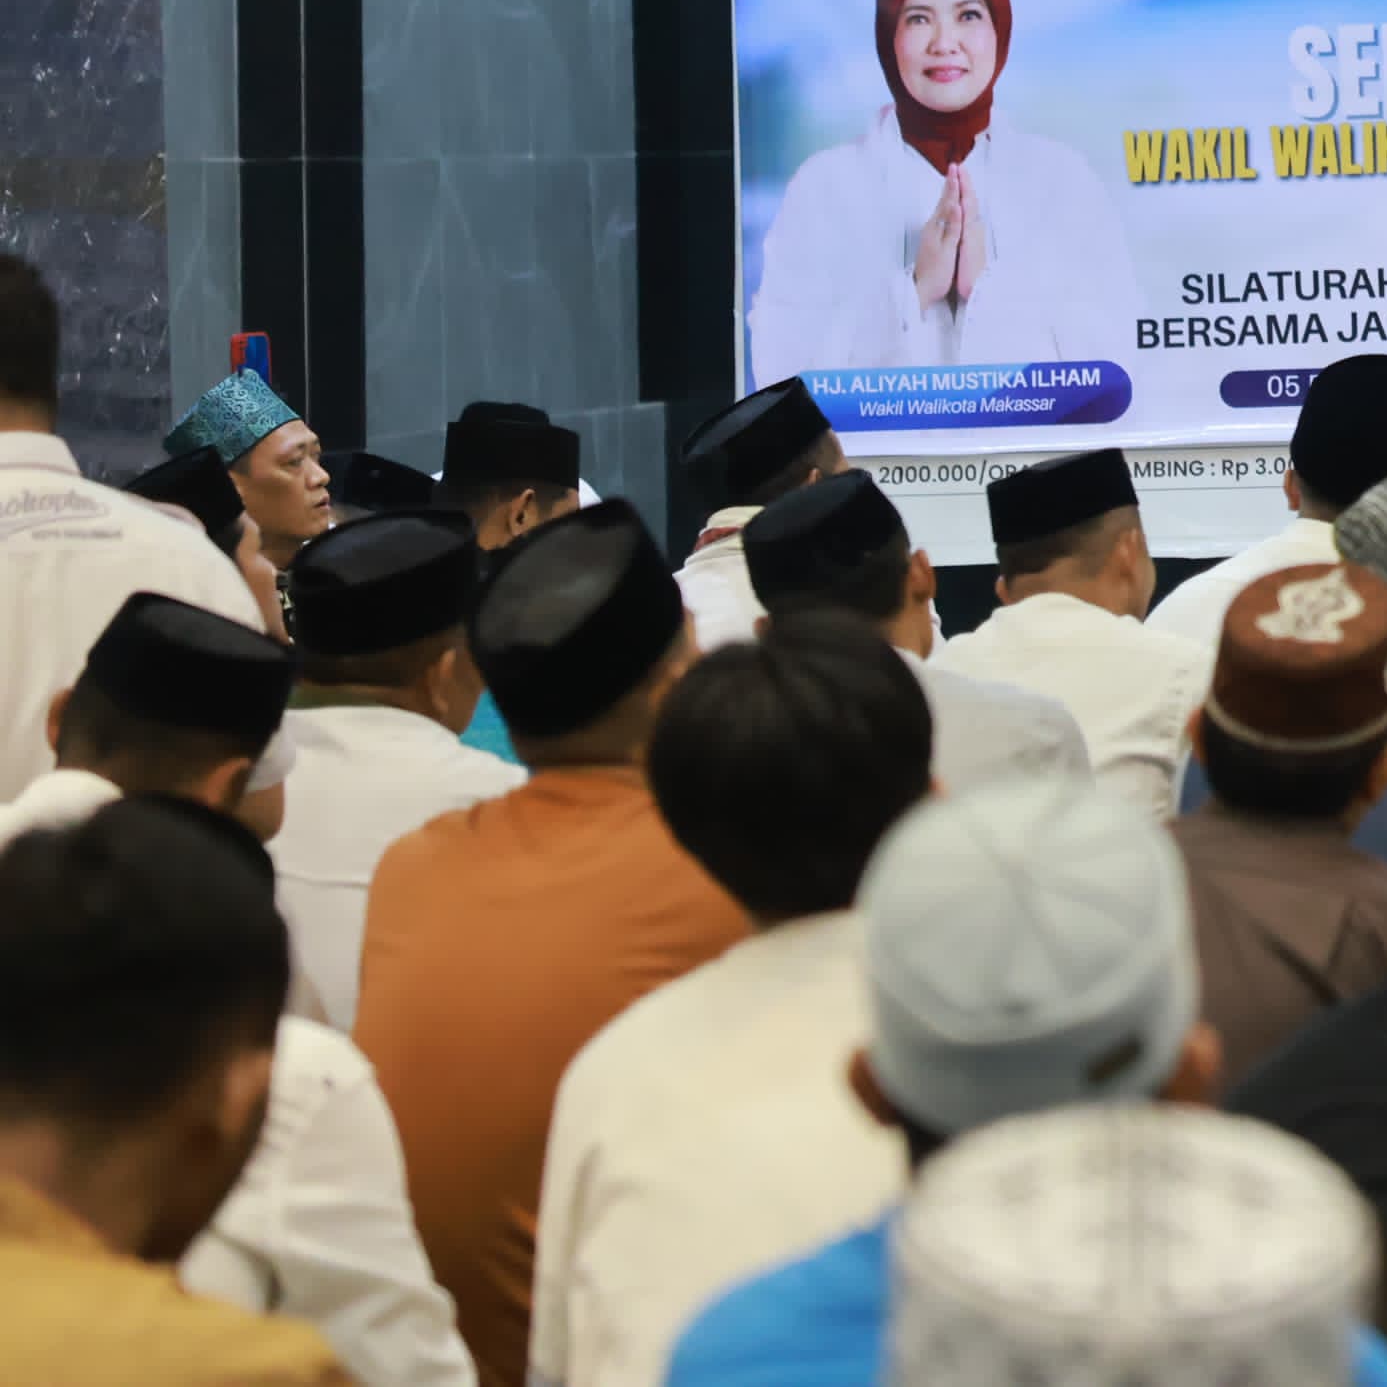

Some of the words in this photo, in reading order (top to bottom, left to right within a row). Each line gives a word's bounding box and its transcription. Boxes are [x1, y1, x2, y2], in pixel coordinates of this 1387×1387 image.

[1123, 127, 1258, 185] WAKIL
[1136, 312, 1329, 350] BERSAMA
[811, 376, 846, 395] HJ.
[850, 373, 929, 393] ALIYAH
[932, 370, 1028, 391] MUSTIKA
[1031, 367, 1101, 388] ILHAM
[1267, 374, 1300, 398] 05
[859, 399, 904, 417] Wakil
[907, 397, 978, 416] Walikota
[979, 395, 1057, 413] Makassar
[1130, 459, 1205, 480] MBING
[1221, 457, 1249, 481] Rp
